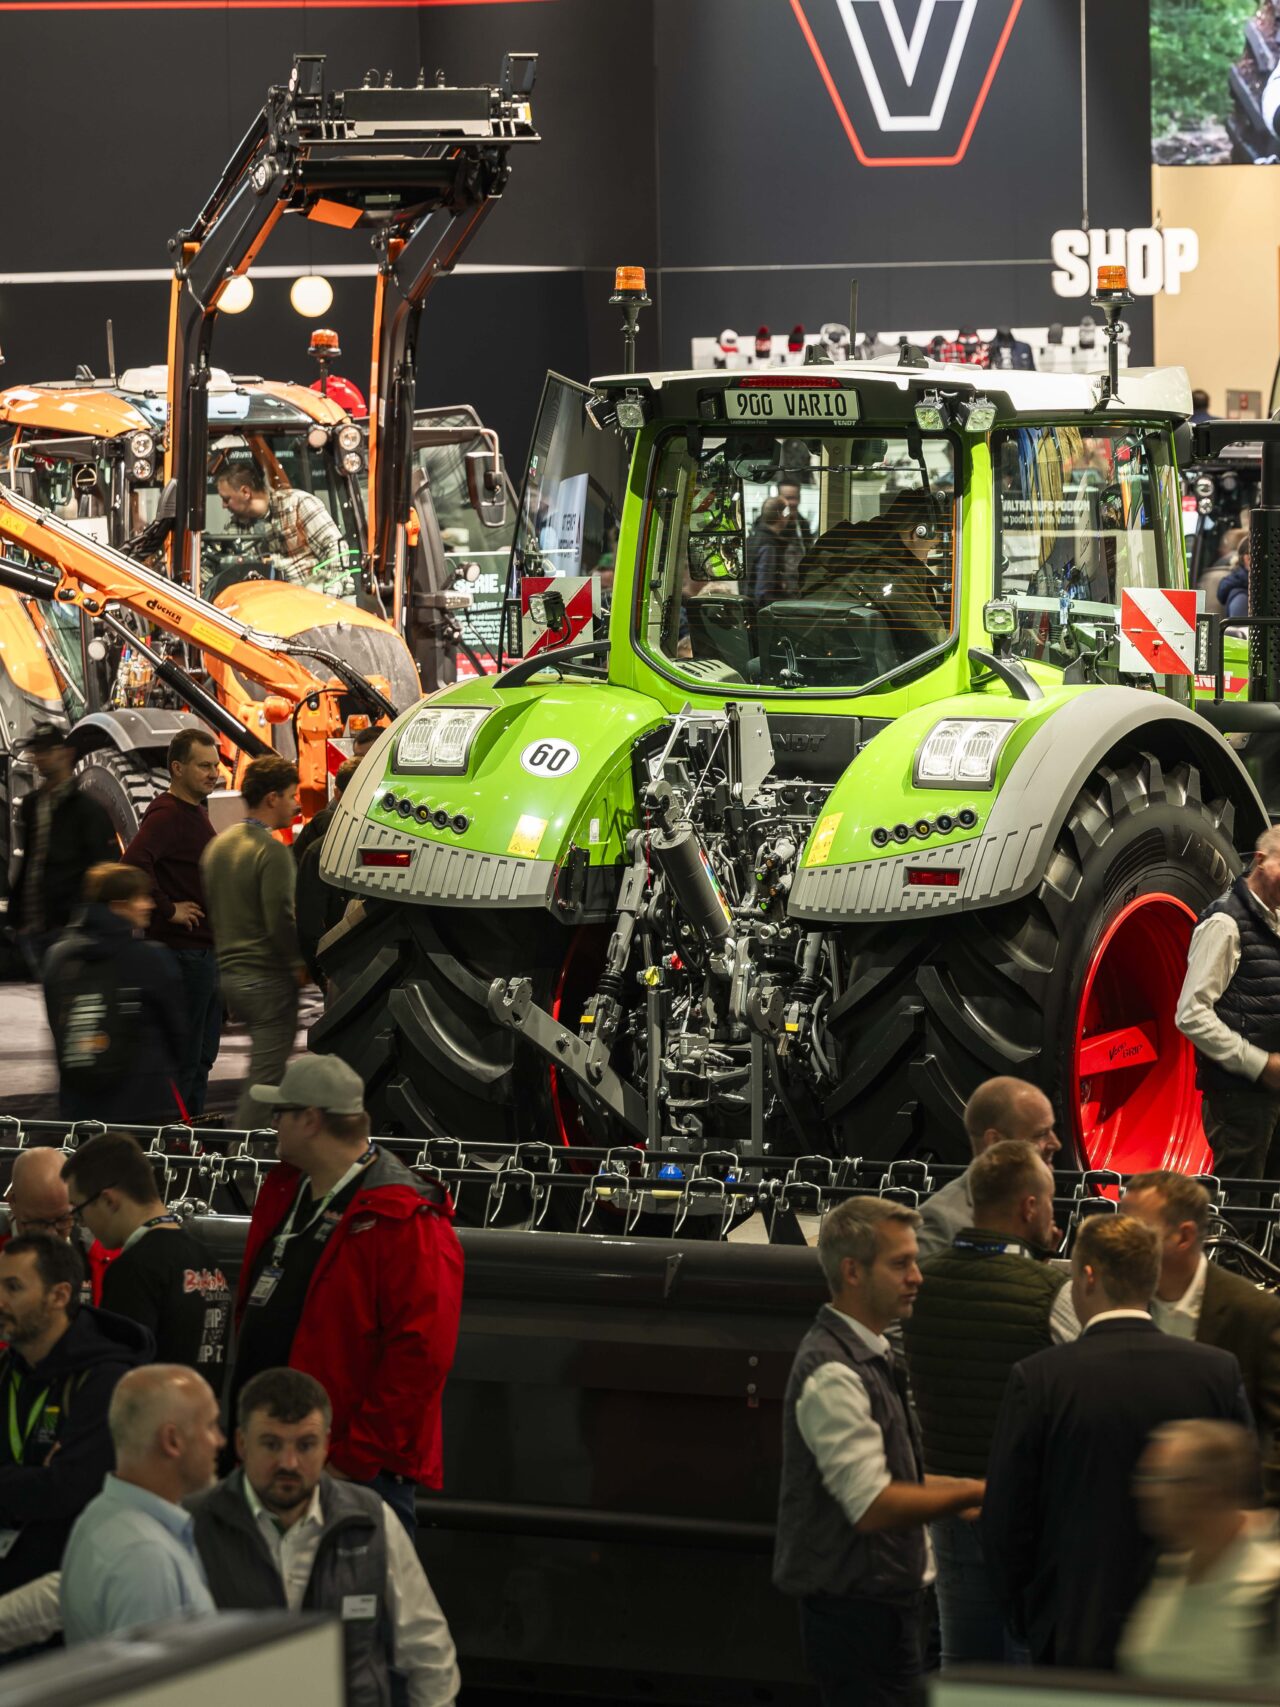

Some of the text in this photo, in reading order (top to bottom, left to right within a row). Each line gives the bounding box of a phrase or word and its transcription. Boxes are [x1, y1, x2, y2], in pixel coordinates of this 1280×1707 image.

[1051, 228, 1199, 297] SHOP
[737, 393, 847, 416] 900 VARIO
[1002, 500, 1031, 511] VALTRA
[772, 733, 826, 751] NDT
[529, 743, 570, 772] 60
